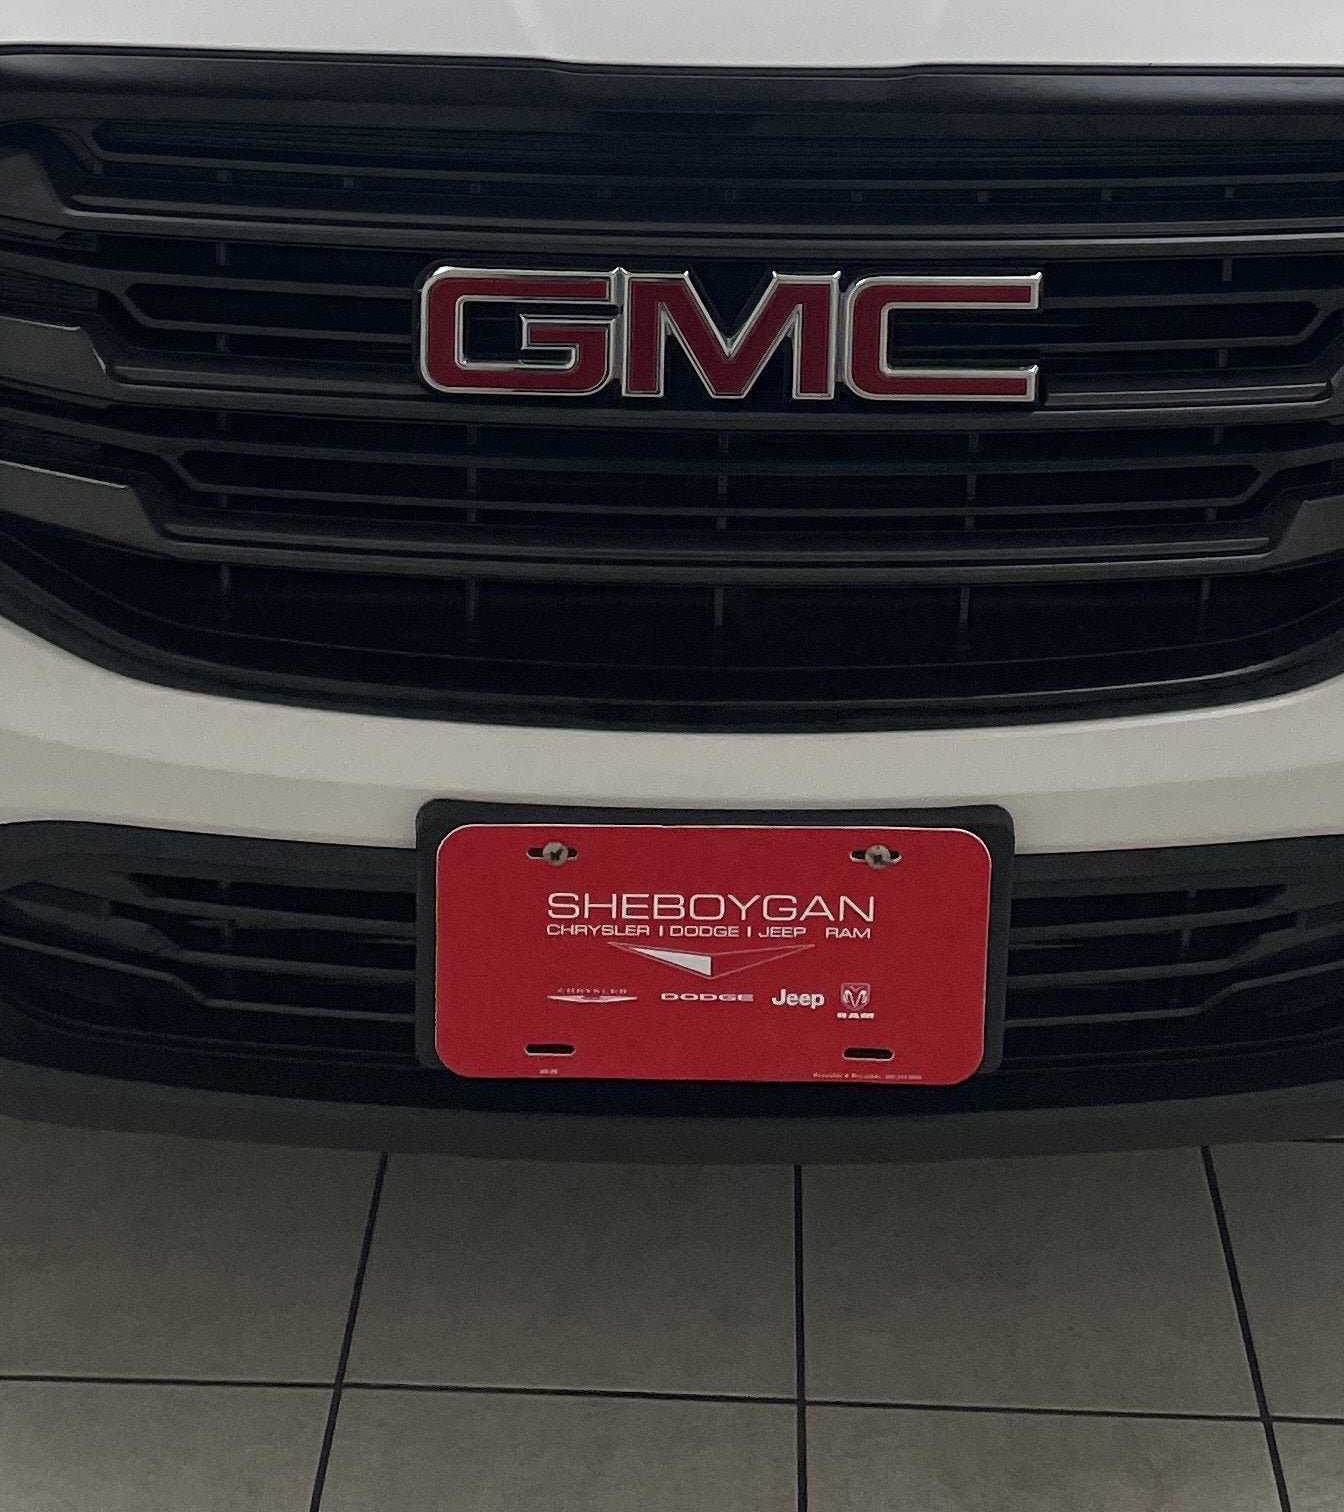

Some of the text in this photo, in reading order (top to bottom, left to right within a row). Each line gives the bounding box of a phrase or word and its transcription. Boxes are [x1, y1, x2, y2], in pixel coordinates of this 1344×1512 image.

[419, 266, 1044, 402] GMC
[547, 892, 875, 922] SHEBOYGAN
[546, 923, 650, 937] CHRYSLER
[669, 925, 740, 938] DODGE
[757, 926, 807, 938] JEEP
[825, 926, 871, 939] RAM
[660, 992, 754, 1002] DODGE
[771, 988, 825, 1010] Jeep
[836, 1012, 875, 1020] RAM
